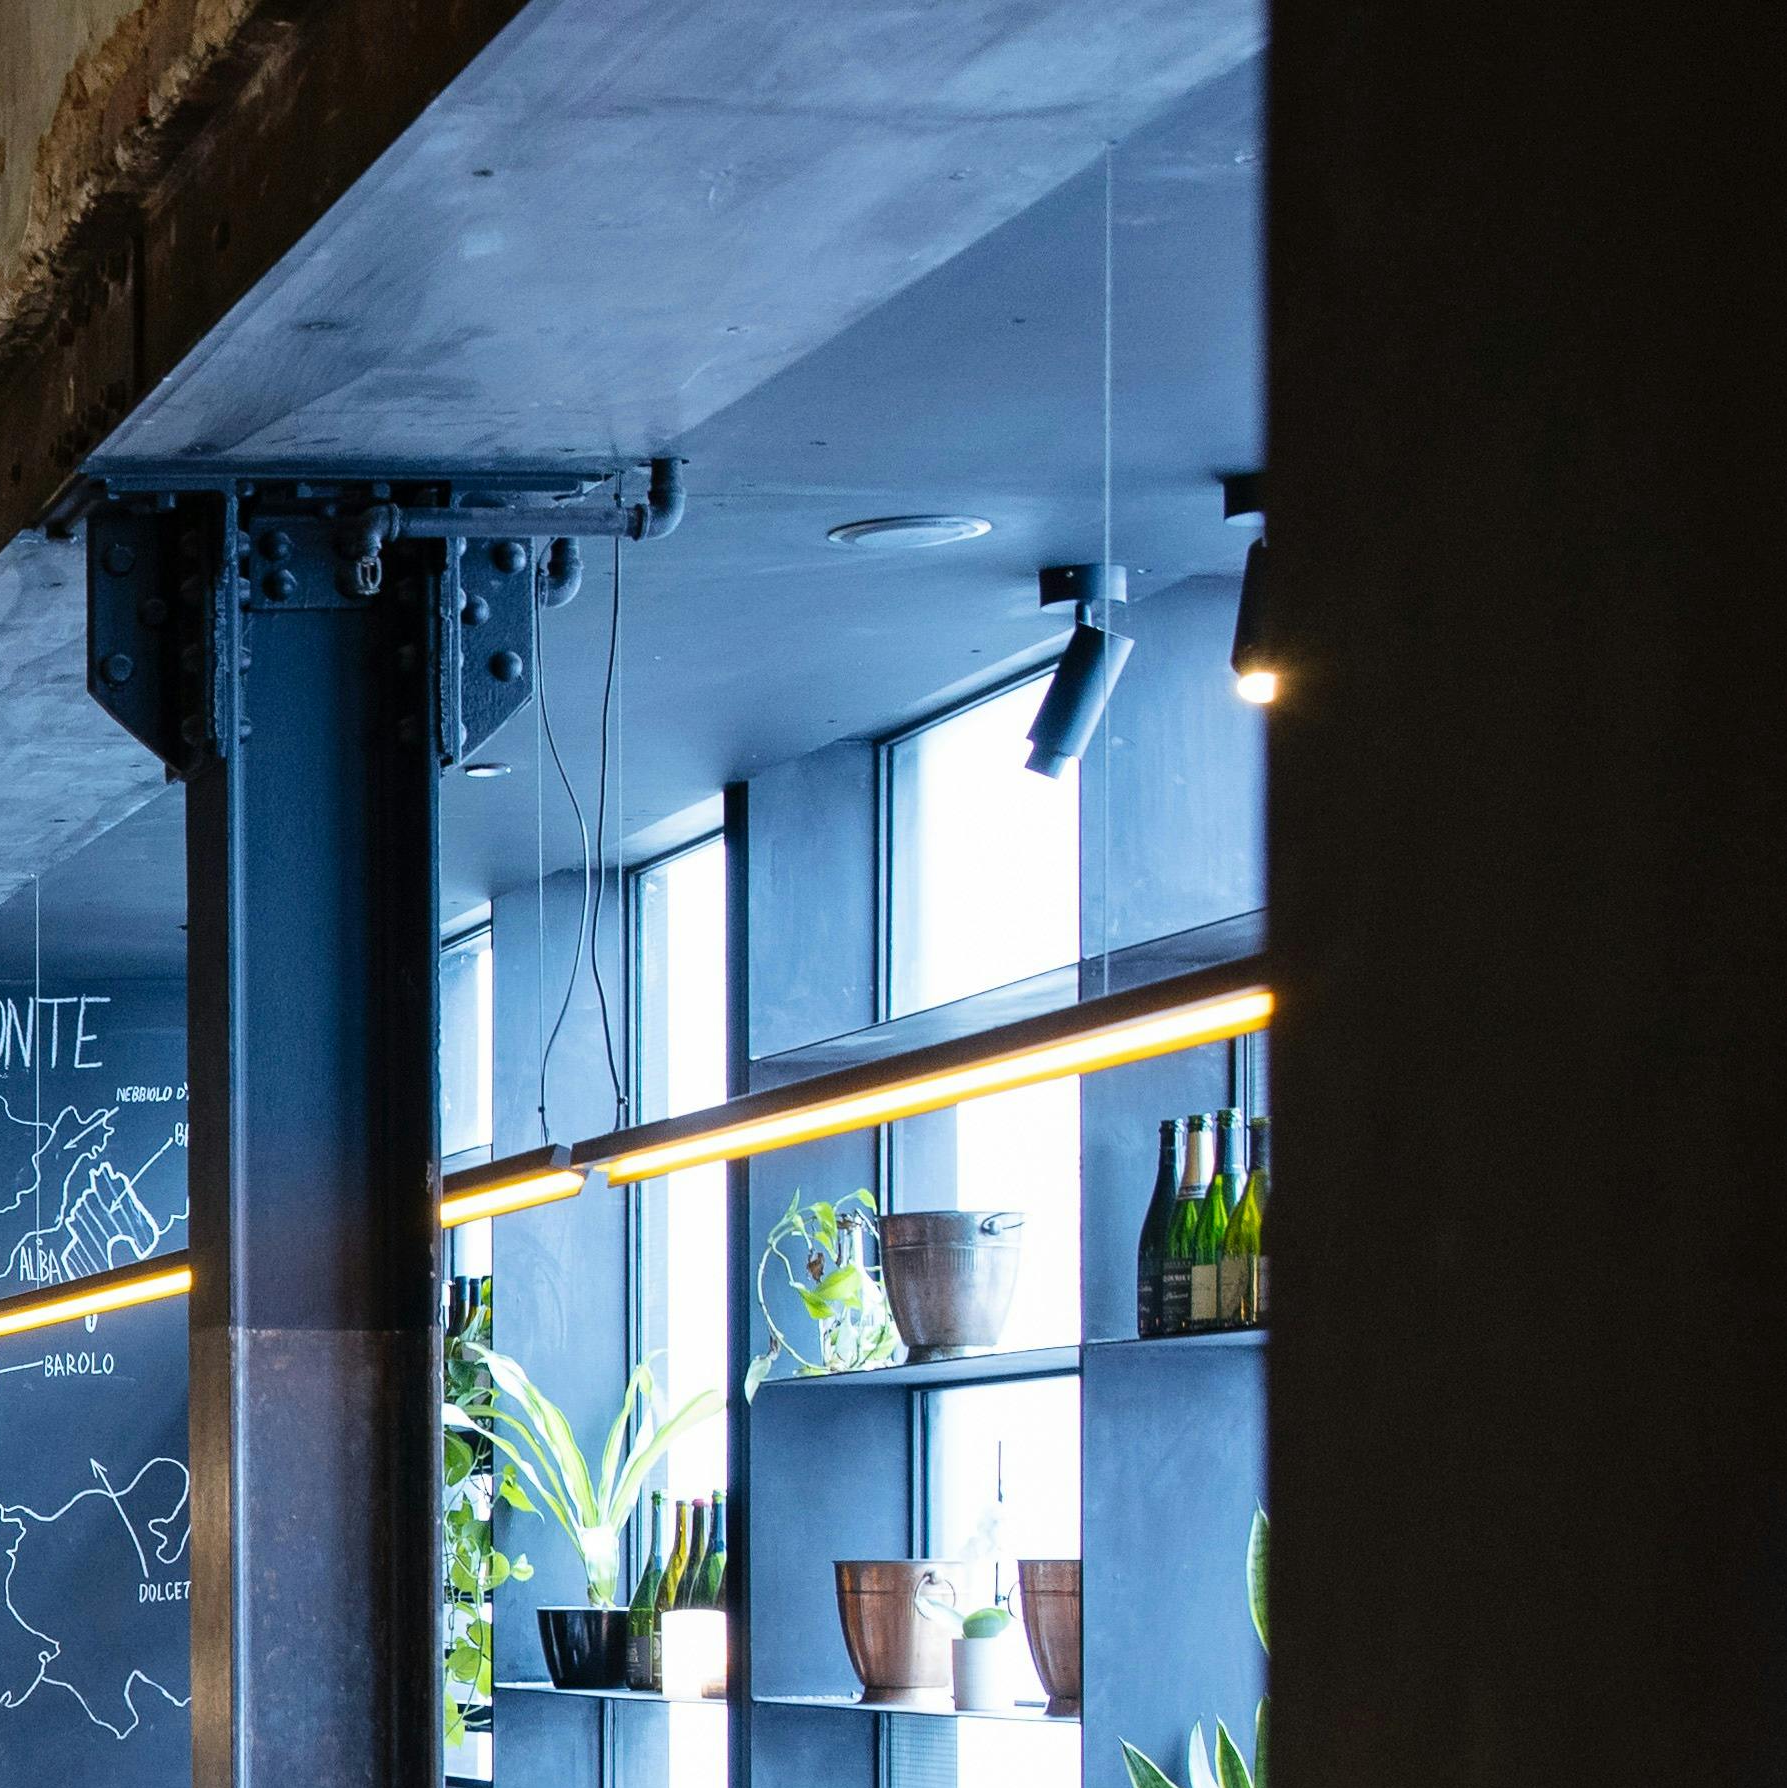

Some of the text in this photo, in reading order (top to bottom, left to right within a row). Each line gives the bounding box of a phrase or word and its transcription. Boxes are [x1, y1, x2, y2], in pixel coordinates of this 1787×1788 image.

[116, 1086, 172, 1102] NEBBIOLO
[19, 1246, 64, 1284] ALBA
[43, 1353, 115, 1375] BAROLO
